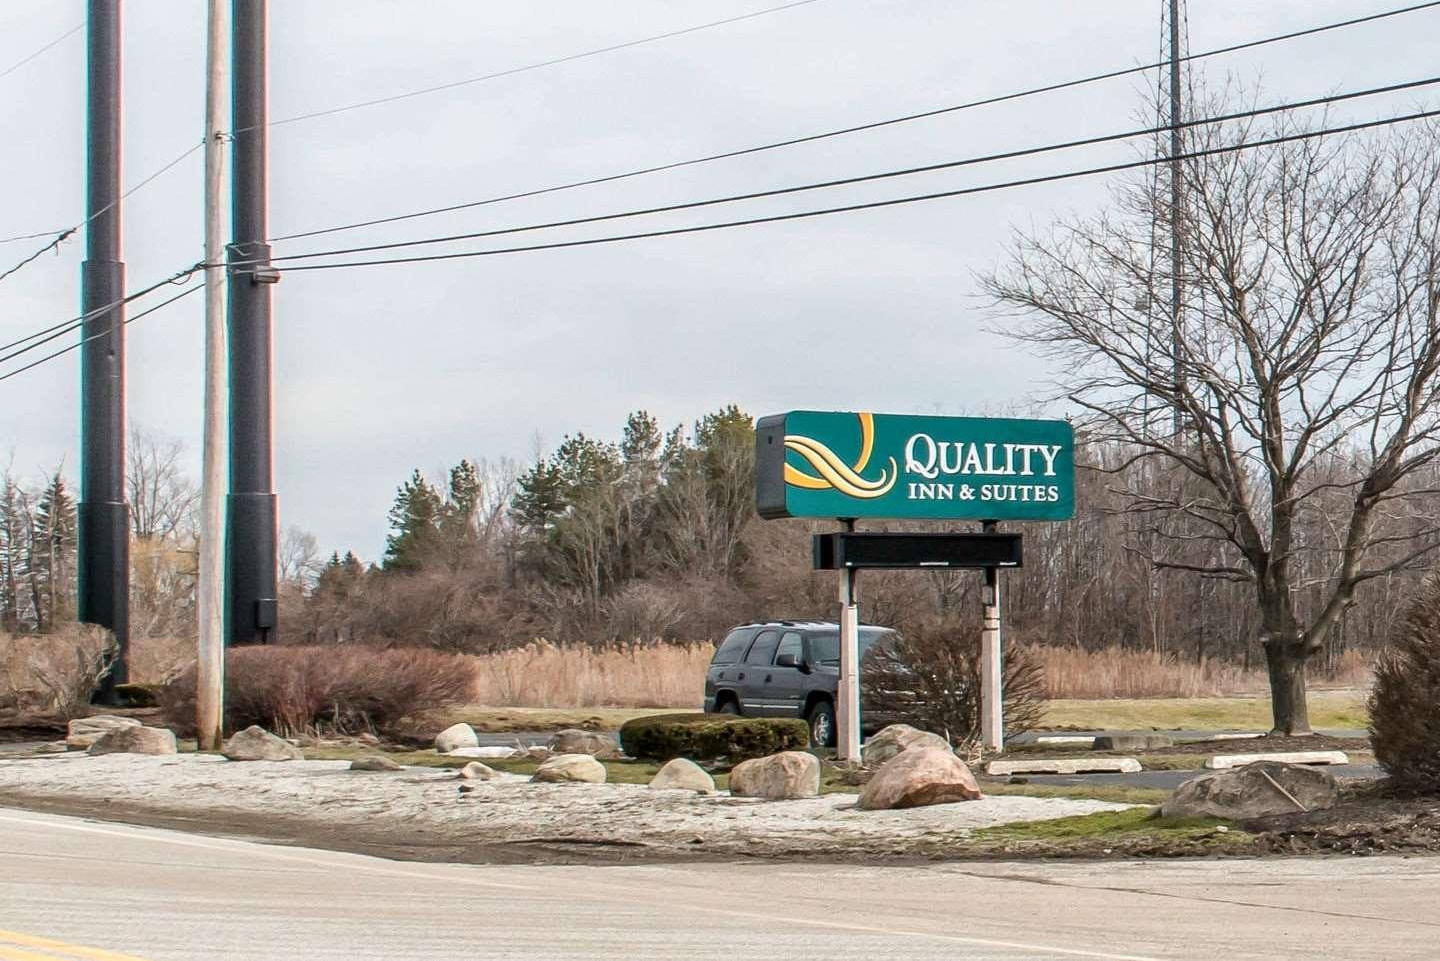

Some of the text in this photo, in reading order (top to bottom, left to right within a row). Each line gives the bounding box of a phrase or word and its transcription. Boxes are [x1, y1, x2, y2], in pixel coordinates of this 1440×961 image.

[904, 433, 1062, 479] QUALITY
[908, 483, 1059, 502] INN & SUITES
